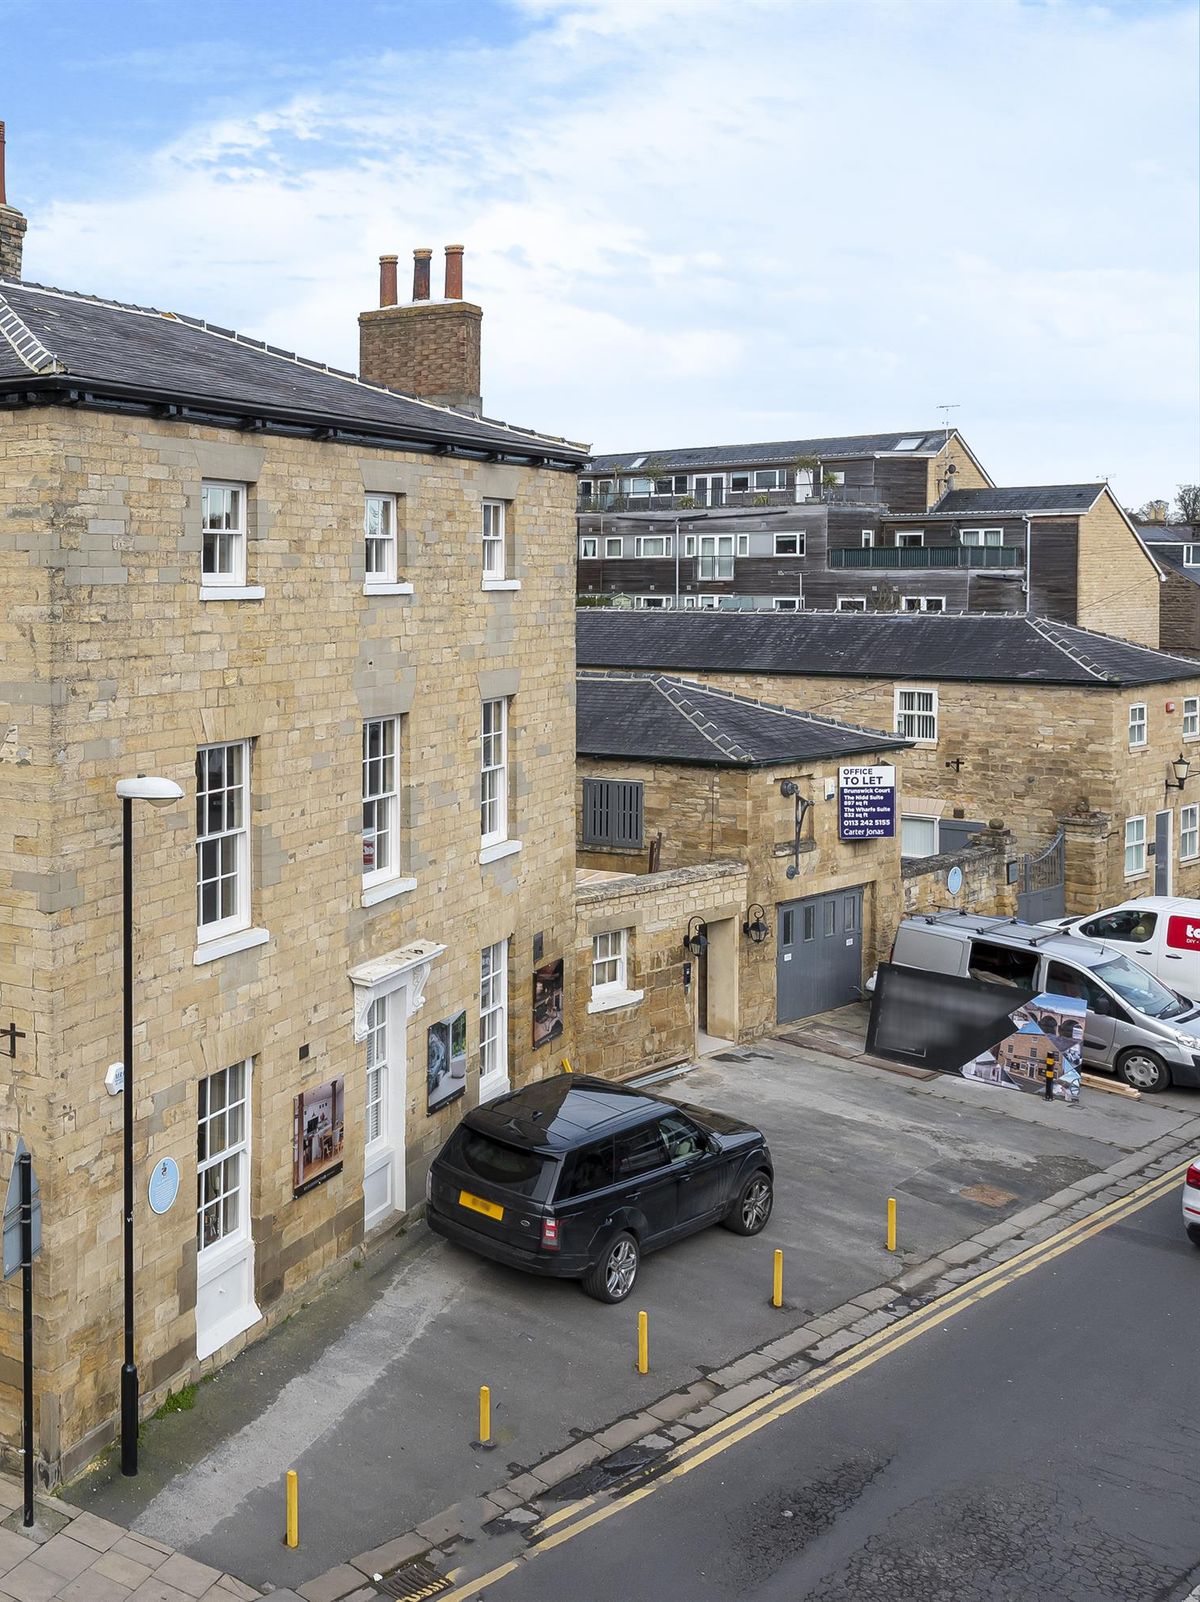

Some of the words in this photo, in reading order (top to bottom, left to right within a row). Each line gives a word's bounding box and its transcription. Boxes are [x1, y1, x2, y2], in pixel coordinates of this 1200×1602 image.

[843, 776, 859, 785] TO
[862, 776, 883, 785] LET
[843, 828, 865, 836] Carter
[865, 828, 884, 837] Jonas
